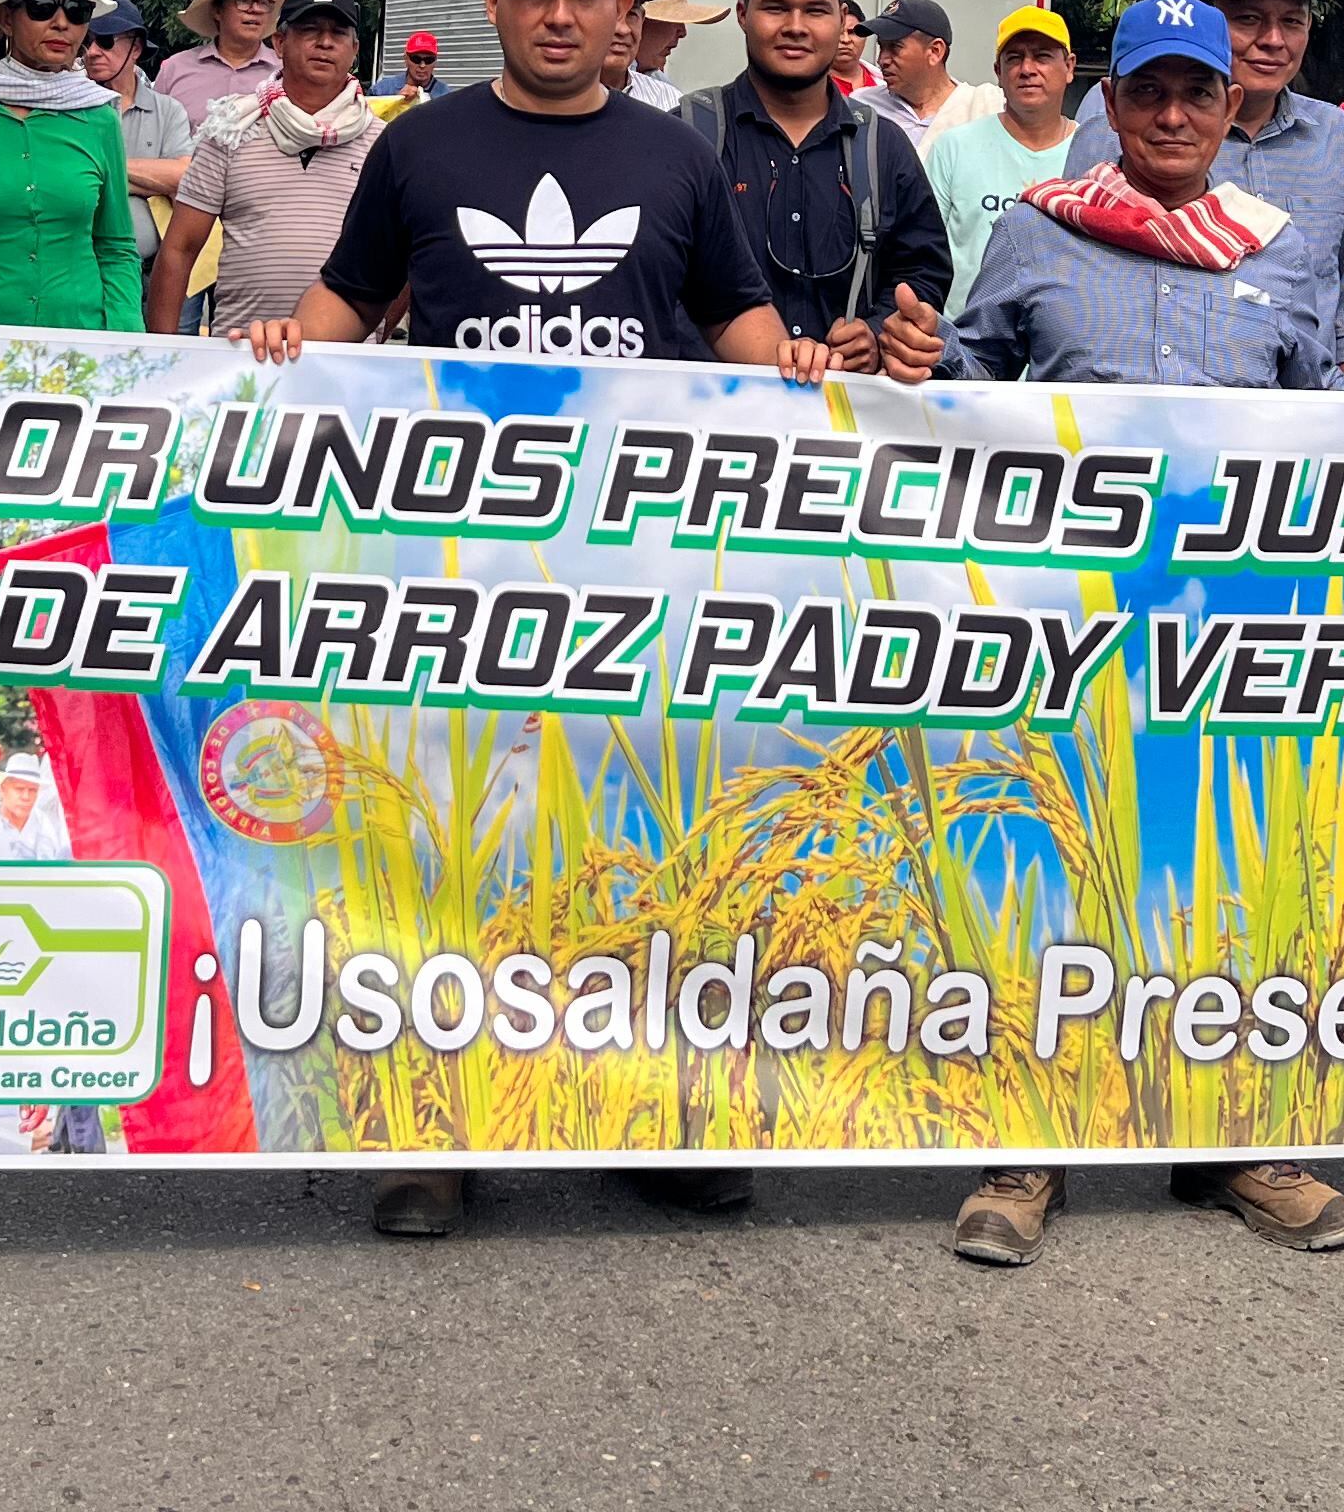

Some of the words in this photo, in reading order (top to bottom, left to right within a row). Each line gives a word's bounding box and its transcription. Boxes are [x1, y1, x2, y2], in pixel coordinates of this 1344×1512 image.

[455, 304, 645, 359] adidas
[194, 402, 588, 525] UNOS
[593, 423, 1164, 558] PRECIOS
[186, 571, 665, 703] ARROZ
[673, 592, 1131, 726] PADDY
[50, 1066, 140, 1088] Crecer
[188, 918, 990, 1087] ¡Usosaldaña
